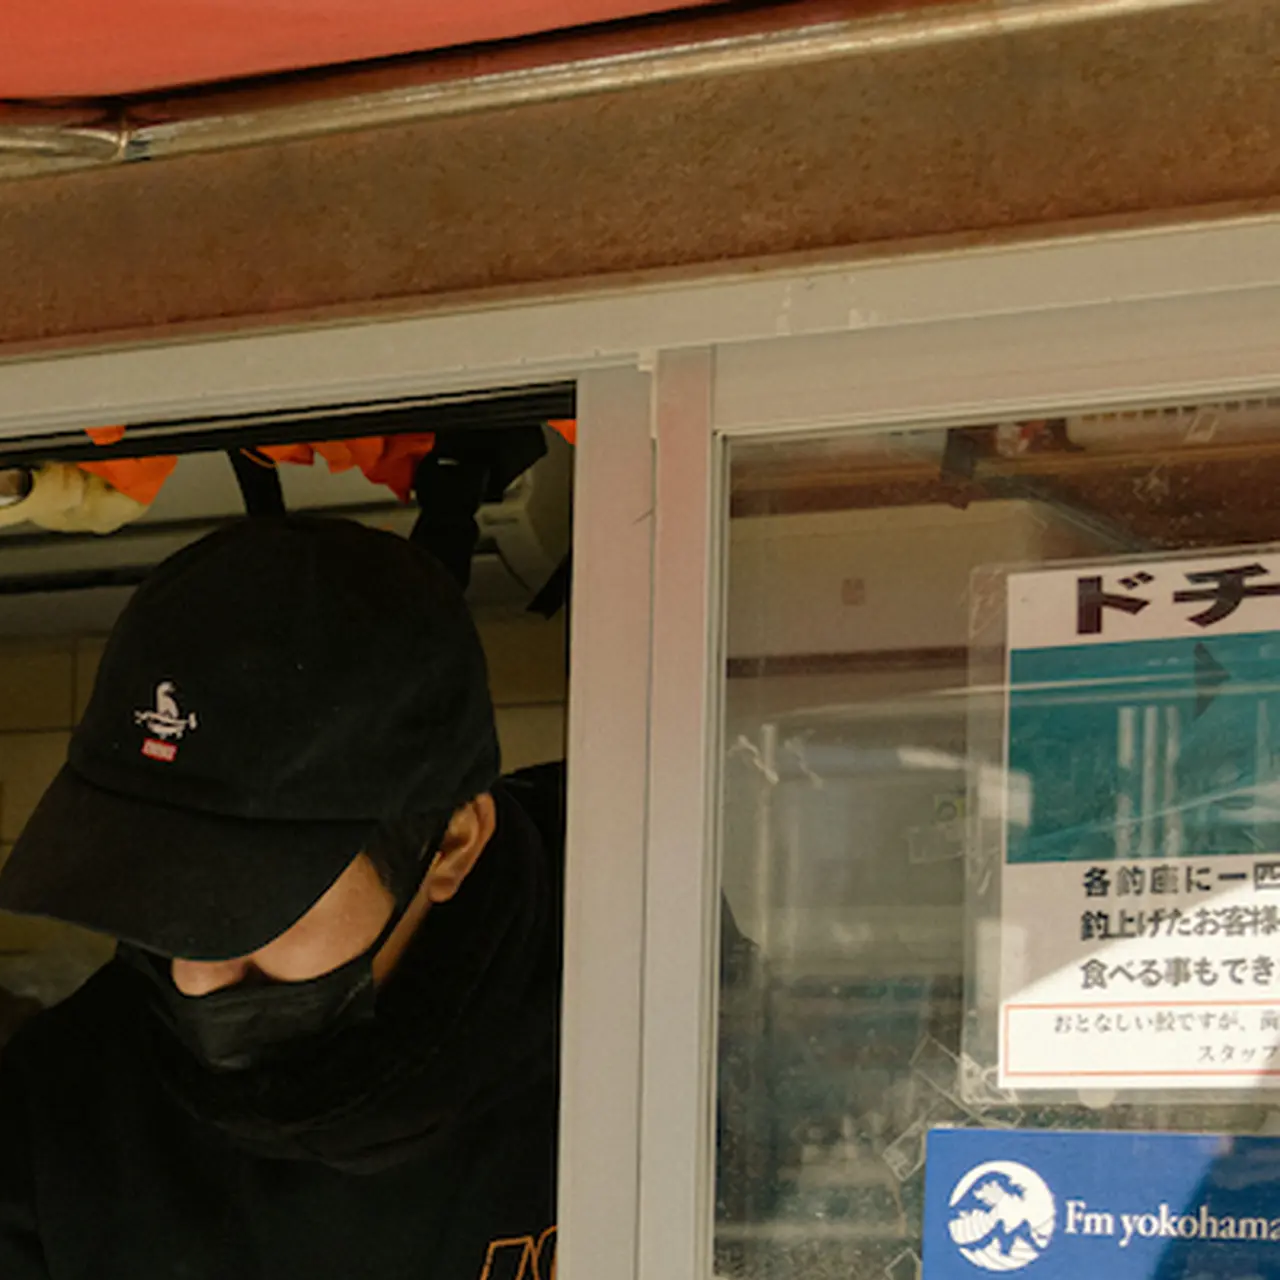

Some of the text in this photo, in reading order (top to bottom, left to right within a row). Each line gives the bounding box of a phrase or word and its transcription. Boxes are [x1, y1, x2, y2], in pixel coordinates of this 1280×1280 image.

[1080, 954, 1276, 992] 食べる事もでき
[1064, 1199, 1116, 1236] Fm
